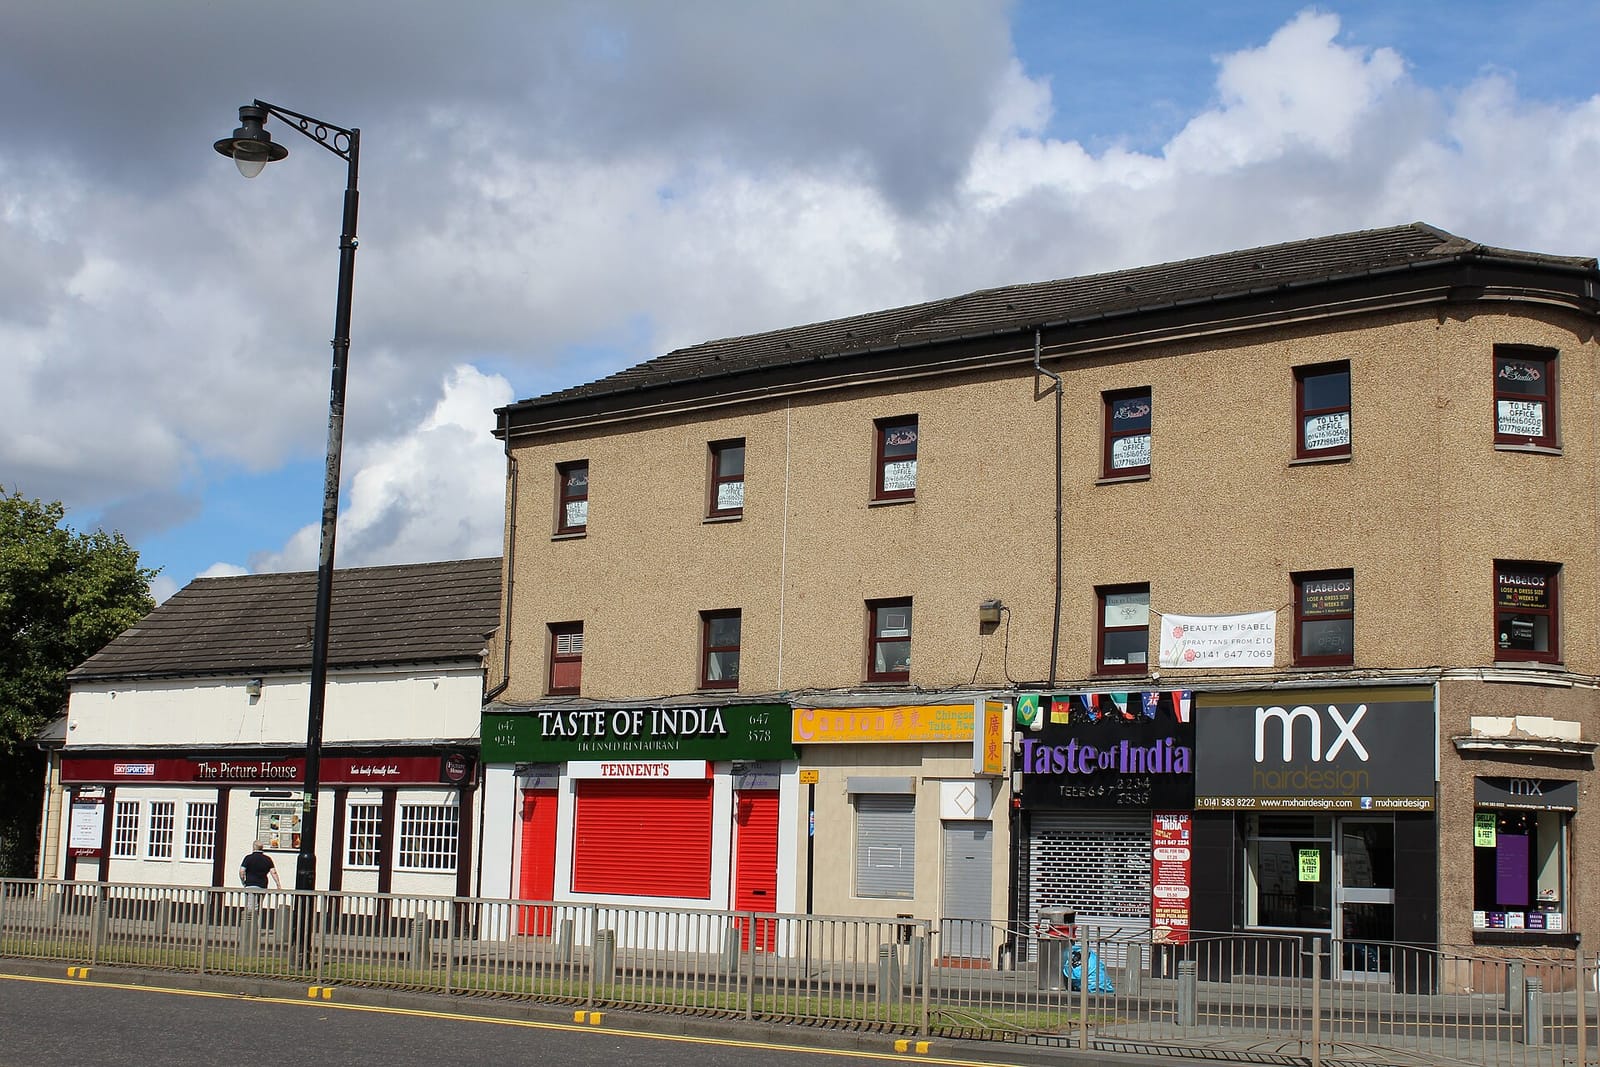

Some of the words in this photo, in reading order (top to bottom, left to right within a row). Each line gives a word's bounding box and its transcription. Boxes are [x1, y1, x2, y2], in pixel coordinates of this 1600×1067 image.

[1509, 402, 1519, 410] TO
[1522, 403, 1536, 411] LET
[1329, 414, 1344, 422] LET
[1509, 410, 1535, 418] OFFICE
[1317, 422, 1342, 431] OFFICE
[1123, 443, 1144, 451] OFFICE
[1237, 623, 1271, 631] ISABEL
[1224, 650, 1243, 658] 647
[1247, 650, 1272, 658] 7069
[538, 711, 605, 736] TASTE
[612, 710, 644, 736] OF
[651, 708, 727, 735] INDIA
[749, 713, 769, 724] 647
[799, 709, 885, 739] Canton
[1254, 704, 1369, 763] mx
[578, 742, 620, 751] LICENSED
[623, 740, 680, 751] RESTAURANT
[1019, 737, 1096, 774] Taste
[1098, 745, 1119, 770] of
[1119, 736, 1192, 774] India
[126, 764, 146, 773] SPORTS
[198, 763, 217, 778] The
[220, 762, 257, 778] Picture
[260, 762, 297, 778] House
[600, 763, 669, 777] TENNENT'S
[1253, 765, 1370, 796] hairdesign
[1509, 779, 1543, 796] mx
[1204, 798, 1219, 807] 0141
[1221, 798, 1235, 807] 583
[1236, 798, 1256, 807] 8222
[1260, 798, 1353, 809] www.mxhairdesign.com
[1375, 798, 1430, 809] mxhairdesign
[1155, 815, 1177, 823] TASTE
[1179, 814, 1189, 823] OF
[1161, 821, 1182, 830] INDIA
[1155, 918, 1170, 926] HALF
